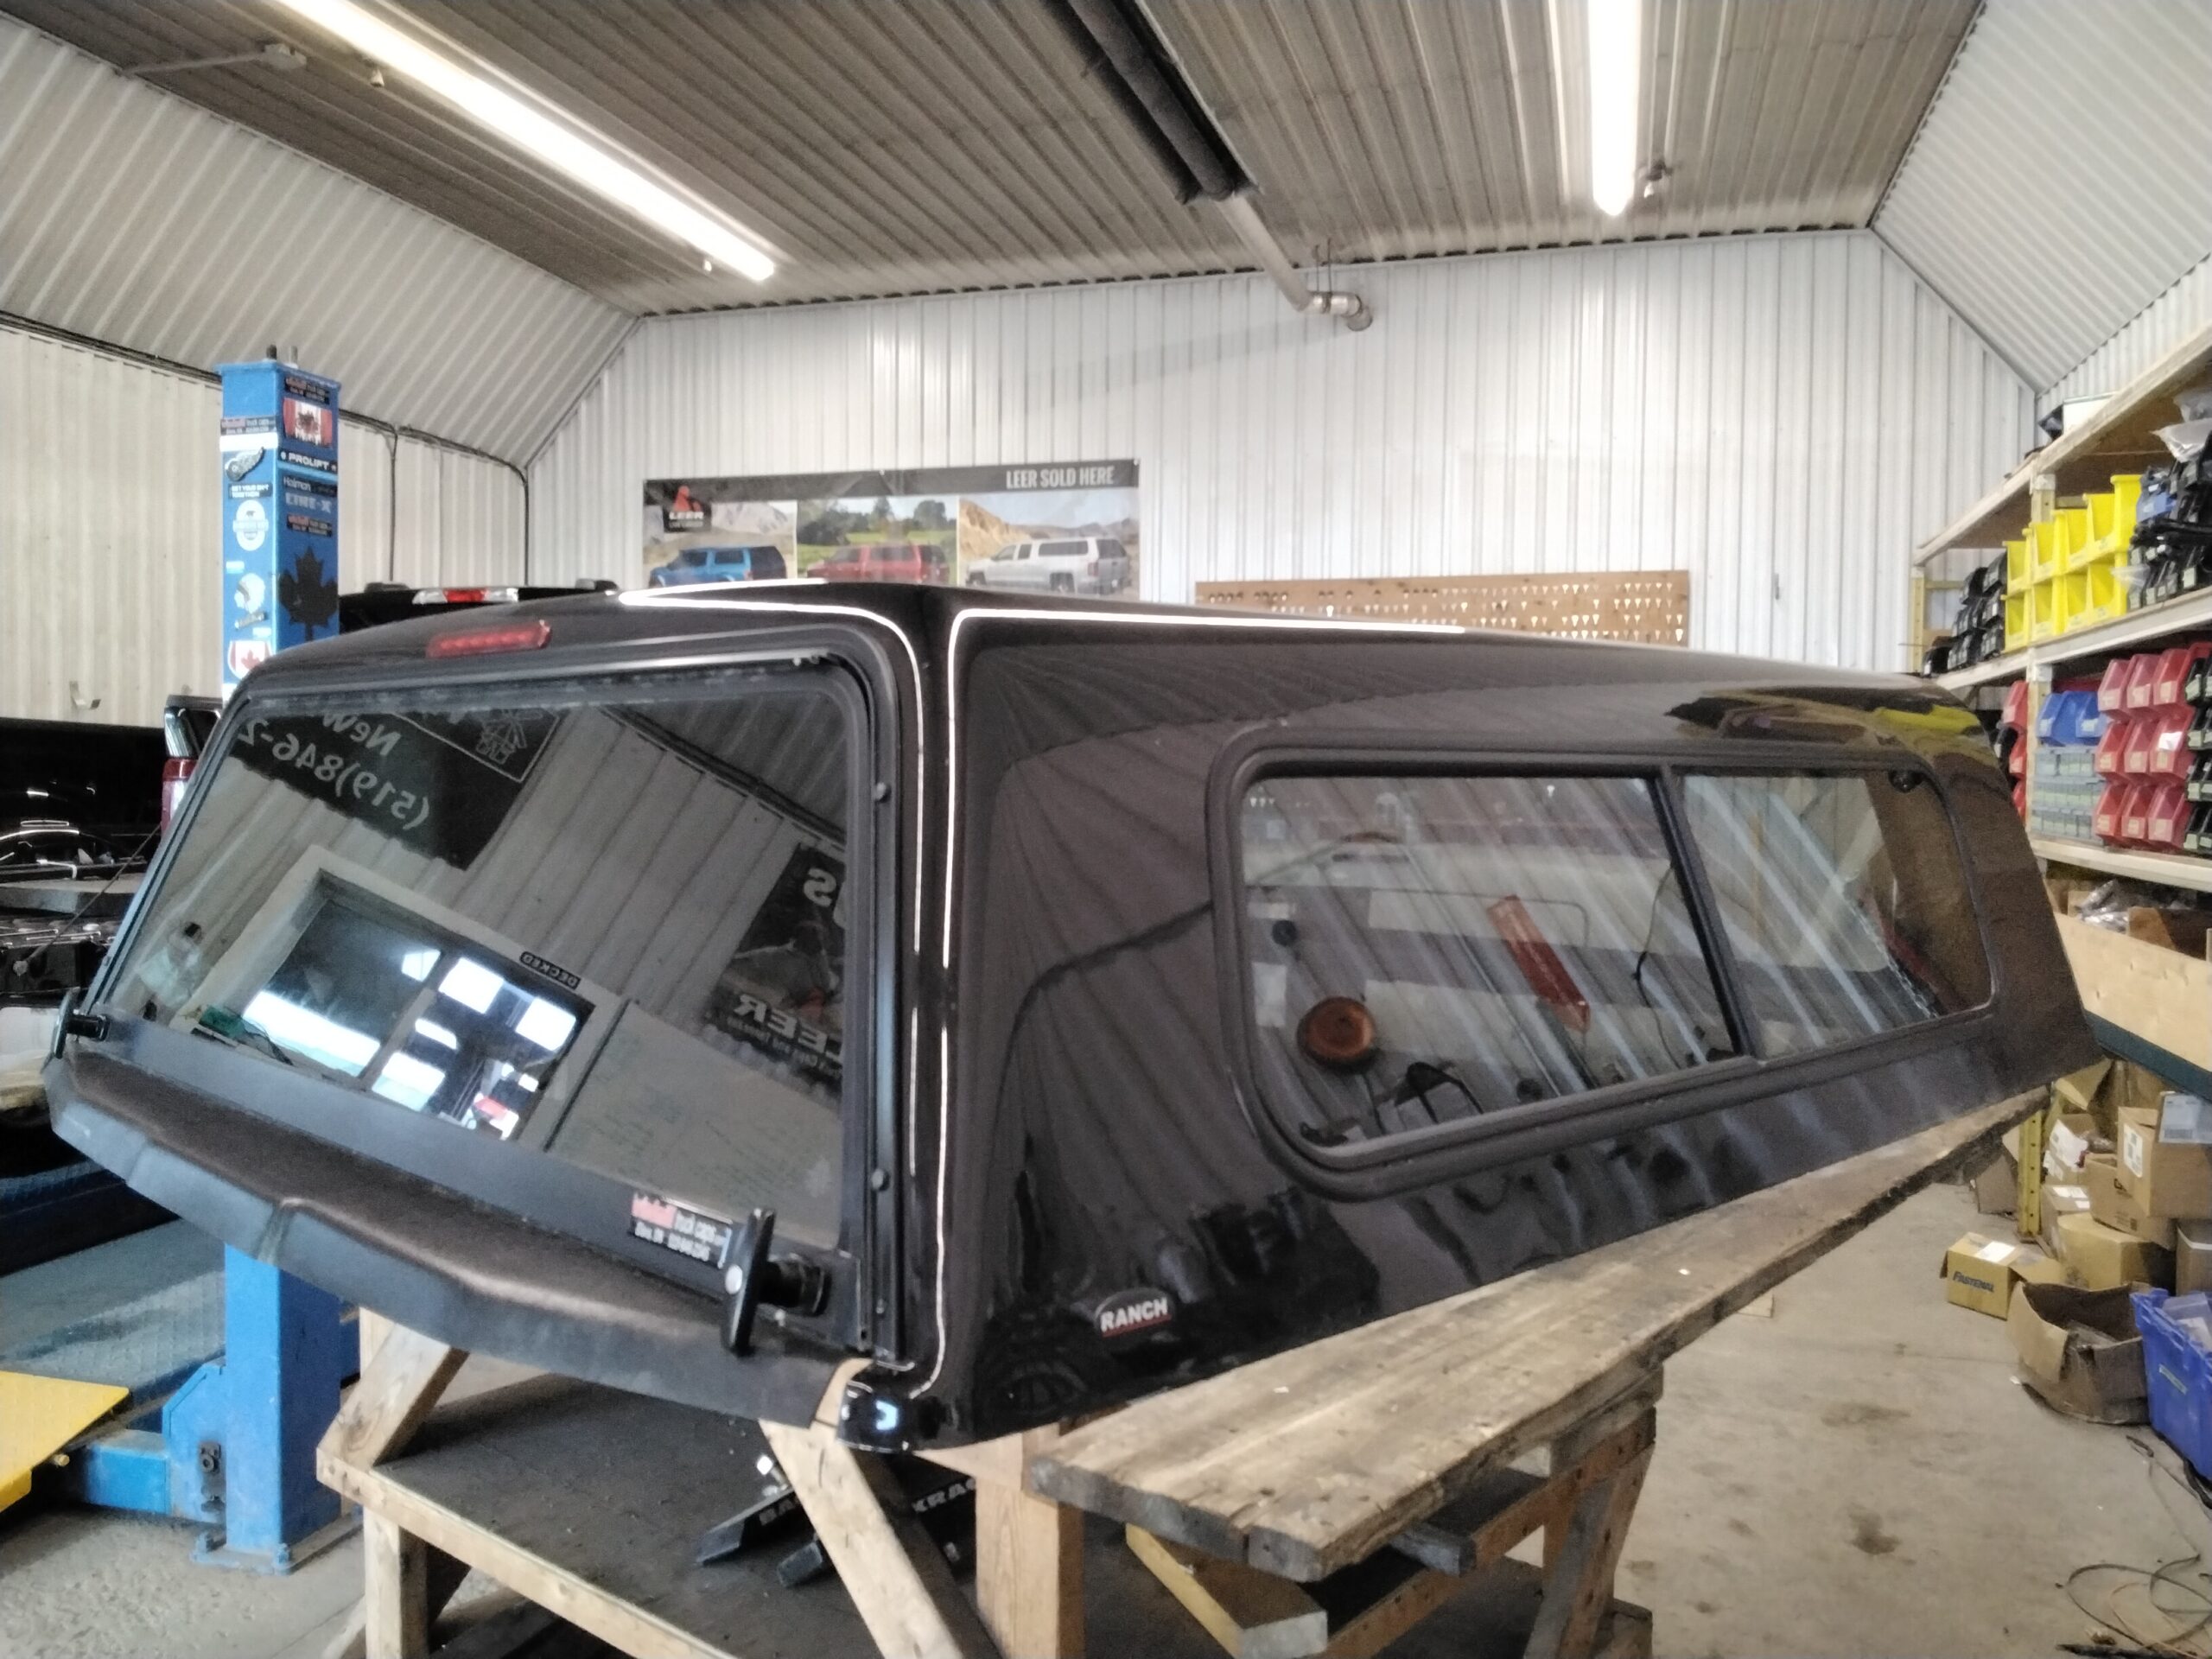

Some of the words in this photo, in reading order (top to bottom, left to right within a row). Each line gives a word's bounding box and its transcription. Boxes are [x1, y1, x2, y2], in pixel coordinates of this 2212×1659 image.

[288, 452, 329, 471] PROLIFT
[1006, 469, 1037, 489] LEER
[1039, 467, 1077, 488] SOLD
[1079, 465, 1115, 486] HERE
[1100, 1297, 1168, 1332] RANCH
